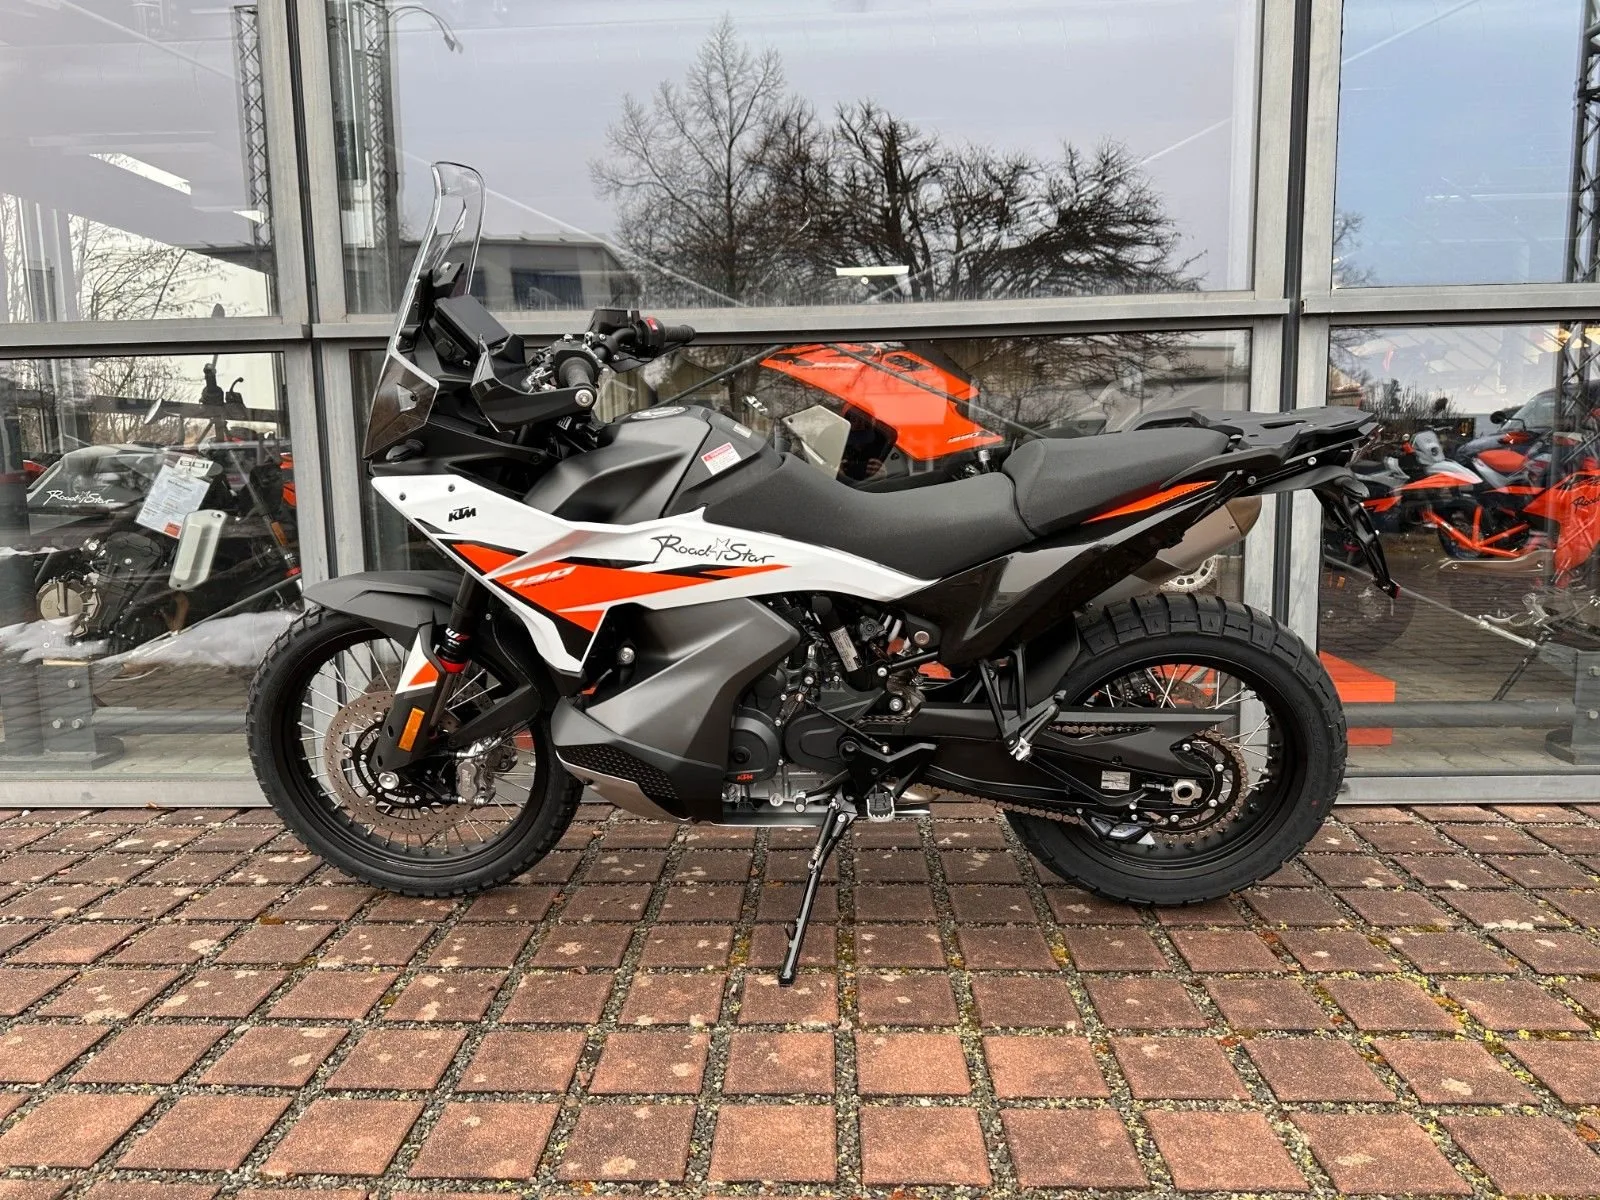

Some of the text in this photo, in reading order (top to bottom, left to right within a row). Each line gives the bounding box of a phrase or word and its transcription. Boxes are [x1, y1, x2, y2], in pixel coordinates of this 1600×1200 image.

[42, 489, 115, 506] Road Star
[448, 506, 477, 522] KTM
[650, 534, 775, 564] Road Star
[505, 565, 577, 588] 790
